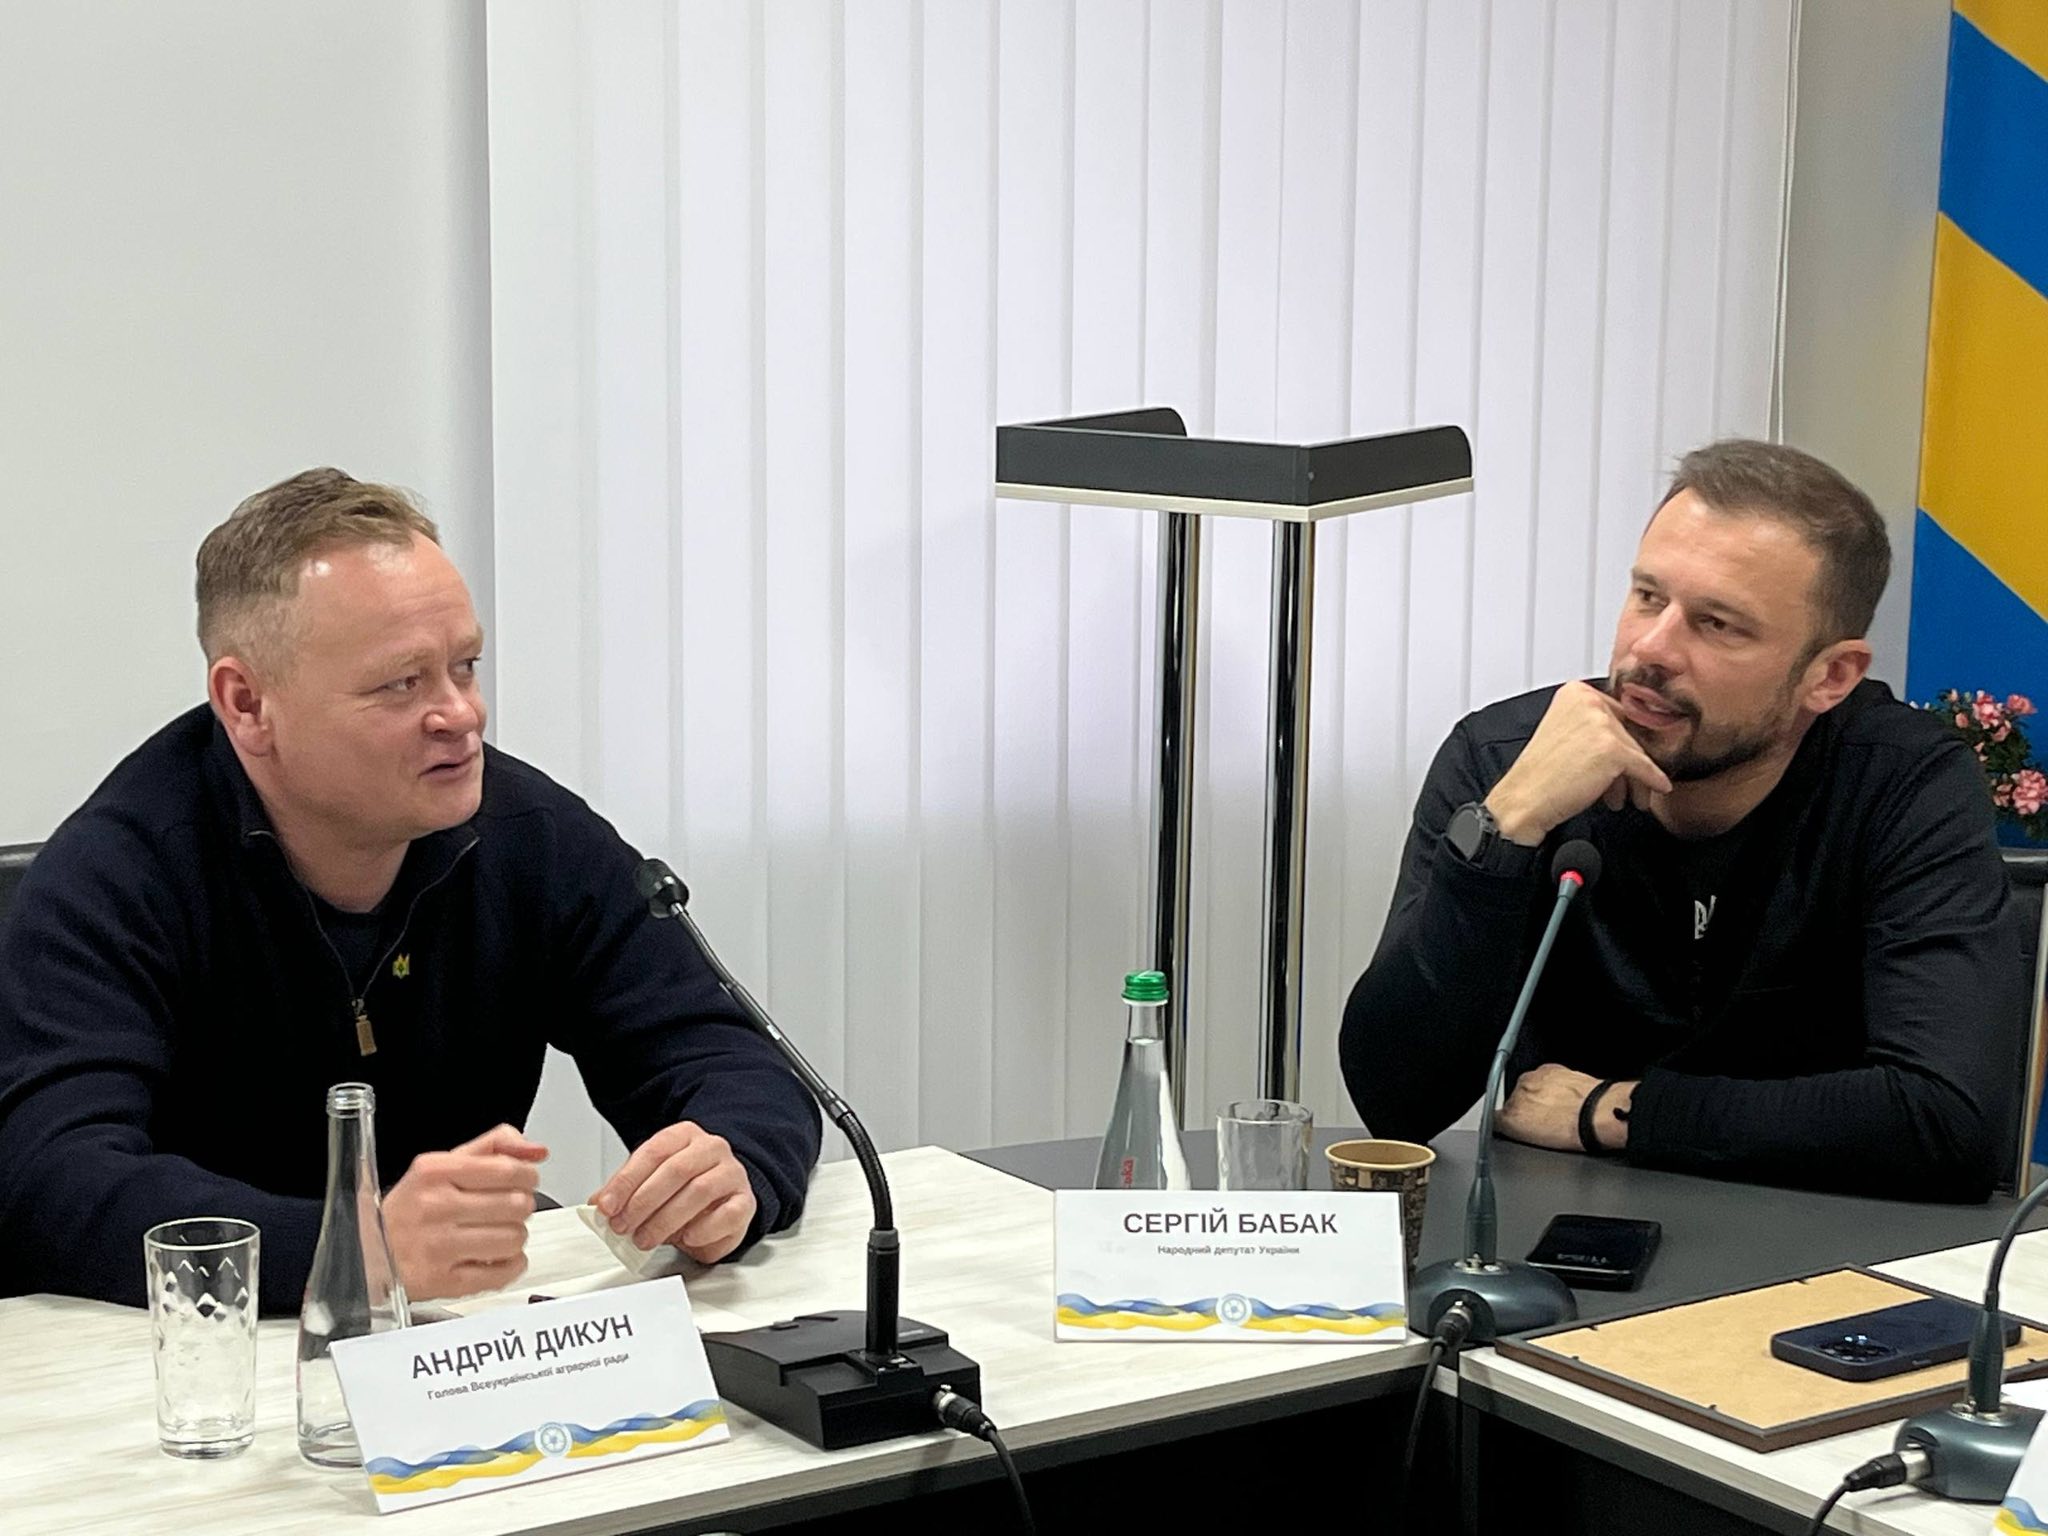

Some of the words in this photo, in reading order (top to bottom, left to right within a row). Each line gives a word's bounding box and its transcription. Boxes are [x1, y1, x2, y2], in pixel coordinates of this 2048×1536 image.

[1123, 1207, 1228, 1234] СЕРГІЙ
[1238, 1213, 1339, 1234] БАБАК
[1157, 1245, 1211, 1256] Народний
[1213, 1246, 1256, 1256] депутат
[1258, 1246, 1300, 1256] України
[412, 1328, 526, 1379] АНДРІЙ
[535, 1314, 634, 1360] ДИКУН
[427, 1384, 469, 1401] Голова
[470, 1367, 554, 1392] Всеукраїнської
[555, 1358, 602, 1375] аграрної
[603, 1353, 630, 1368] ради
